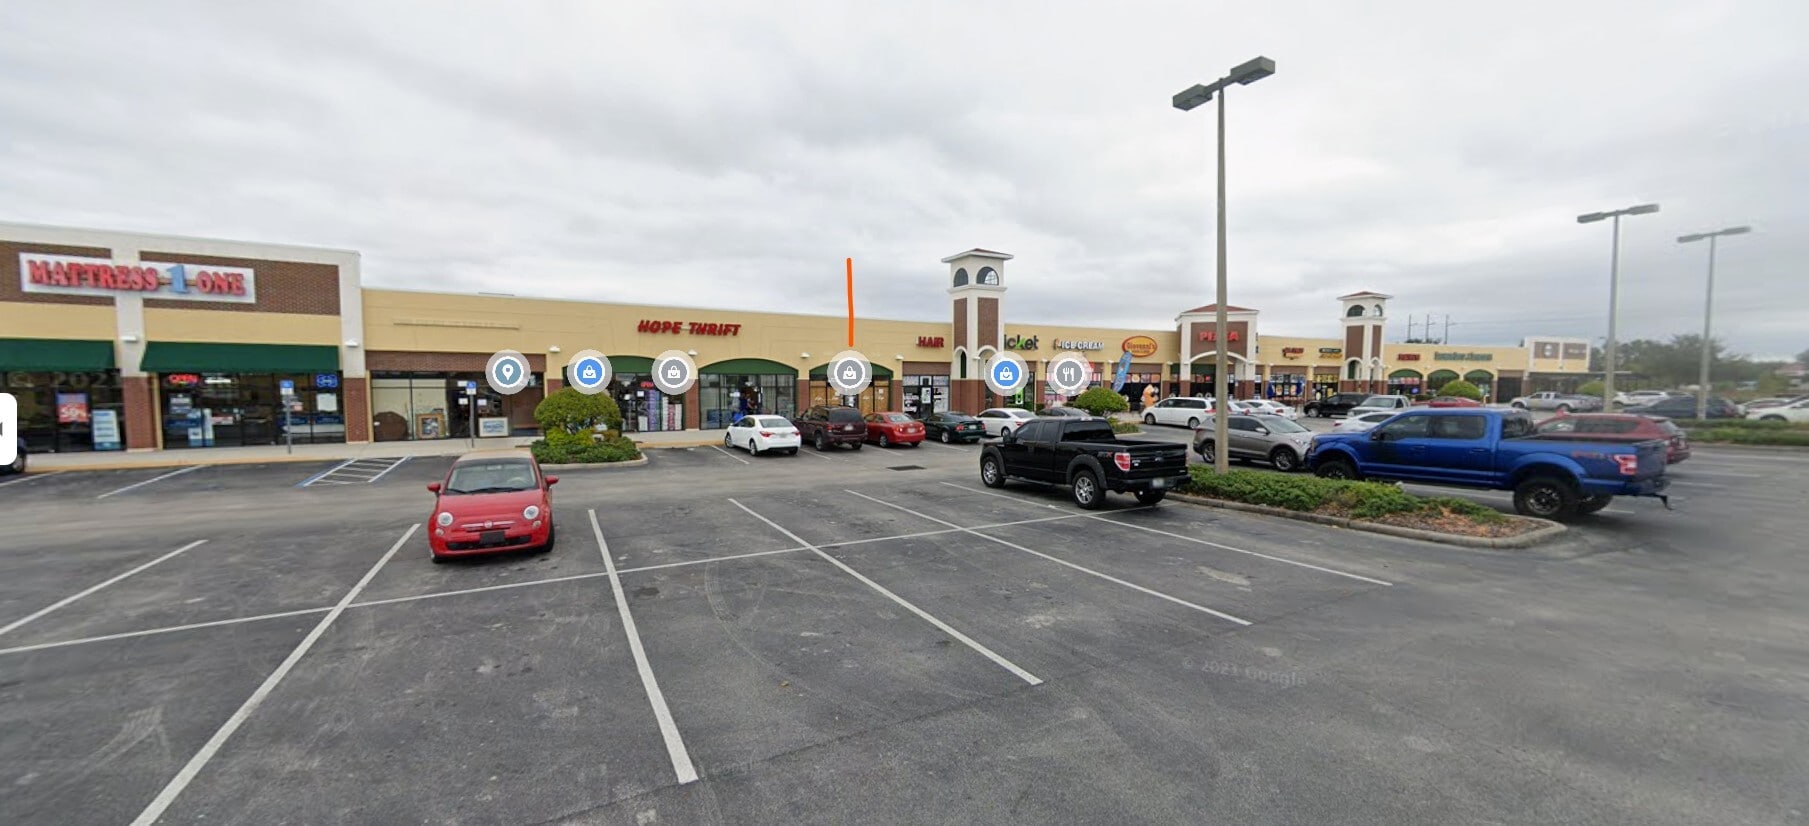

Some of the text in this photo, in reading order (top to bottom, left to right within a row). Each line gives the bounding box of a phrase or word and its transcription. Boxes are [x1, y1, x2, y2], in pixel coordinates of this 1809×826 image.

[27, 260, 247, 296] MATTRESS 1 ONE
[637, 319, 742, 336] HOPE THRIFT
[918, 336, 945, 348] HAIR
[1199, 331, 1240, 342] PIA
[1061, 340, 1105, 351] ICE CREAM
